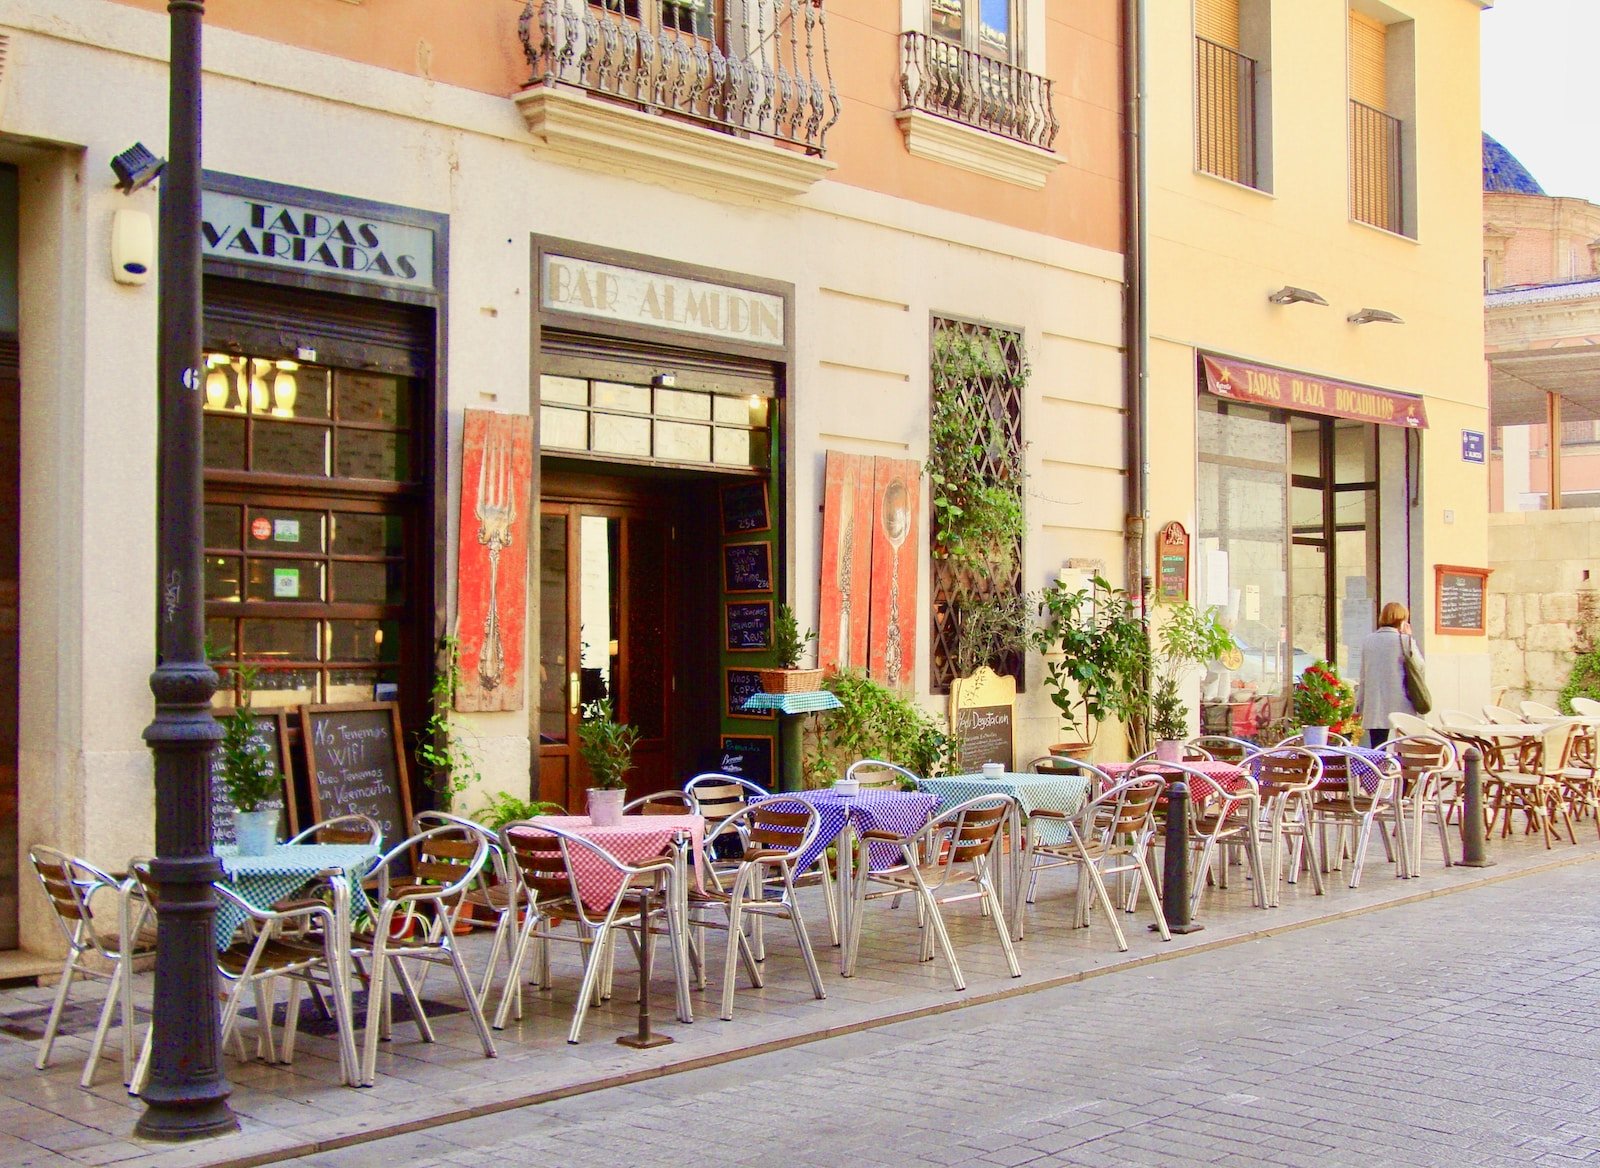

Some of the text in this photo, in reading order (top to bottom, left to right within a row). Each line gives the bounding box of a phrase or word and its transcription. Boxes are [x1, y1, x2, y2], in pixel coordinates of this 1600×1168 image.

[244, 201, 379, 249] TAPAS
[201, 220, 417, 280] VARIADAS
[550, 261, 780, 339] BAR ALMUDIN
[1245, 369, 1394, 420] TAPAS PLAZA BOCADILLOS
[315, 719, 388, 746] No Tenemos
[339, 768, 383, 782] Tenemos
